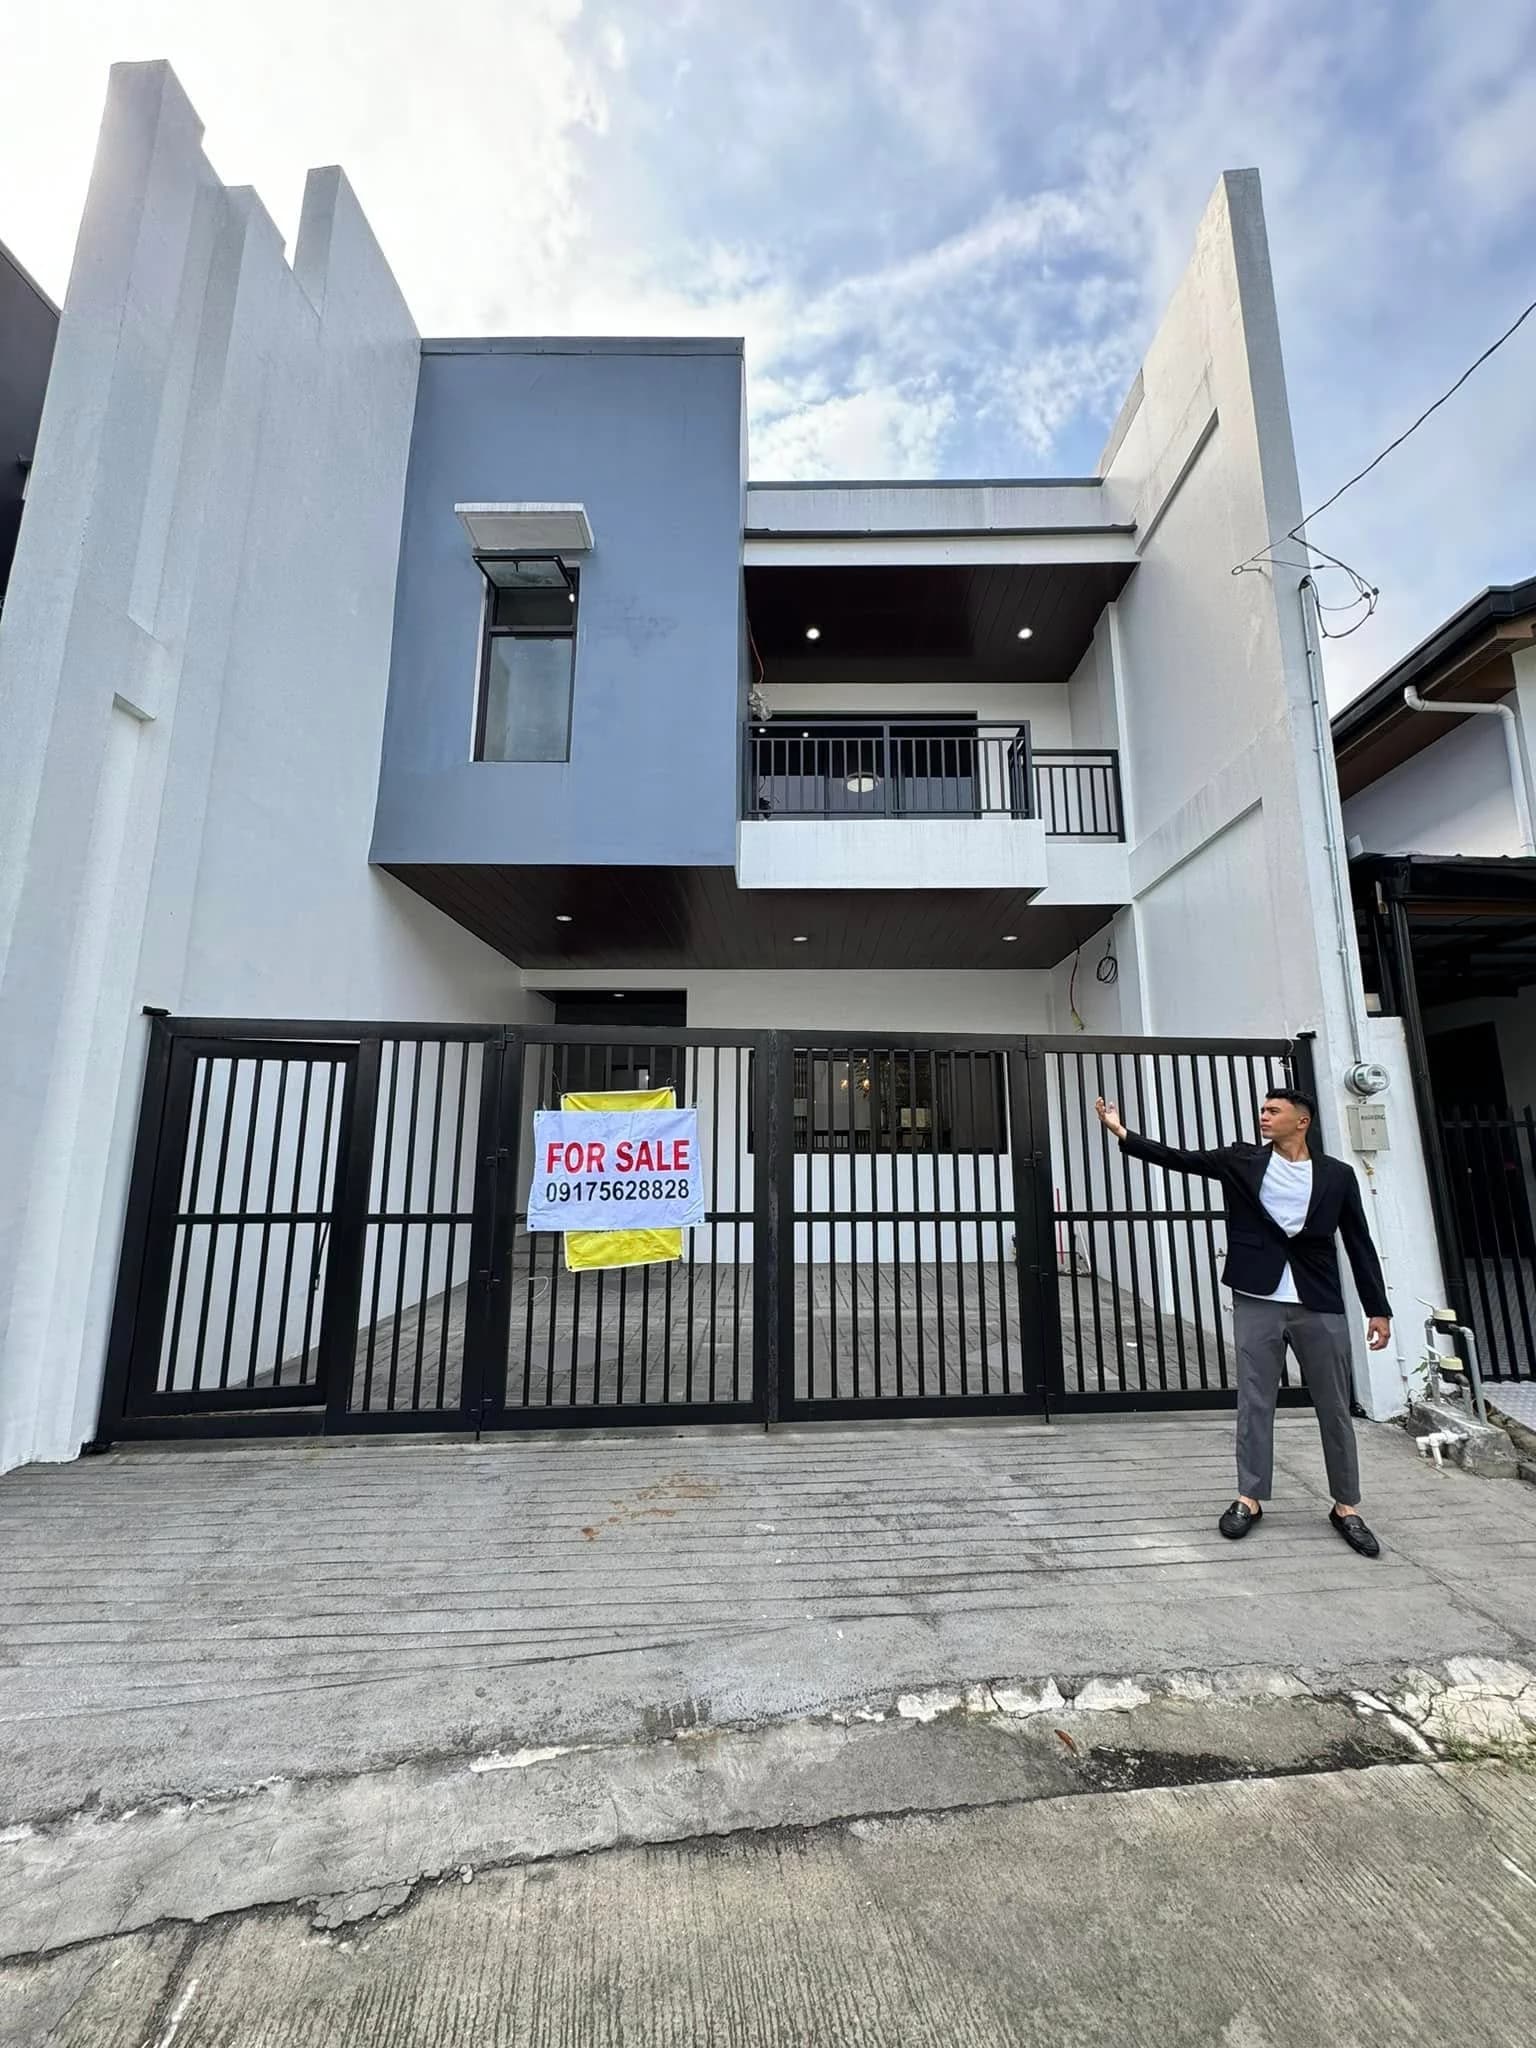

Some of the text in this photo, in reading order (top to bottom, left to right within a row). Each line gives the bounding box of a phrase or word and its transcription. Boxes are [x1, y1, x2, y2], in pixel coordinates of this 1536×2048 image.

[547, 1140, 690, 1173] FOR SALE
[546, 1179, 690, 1203] 09175628828
